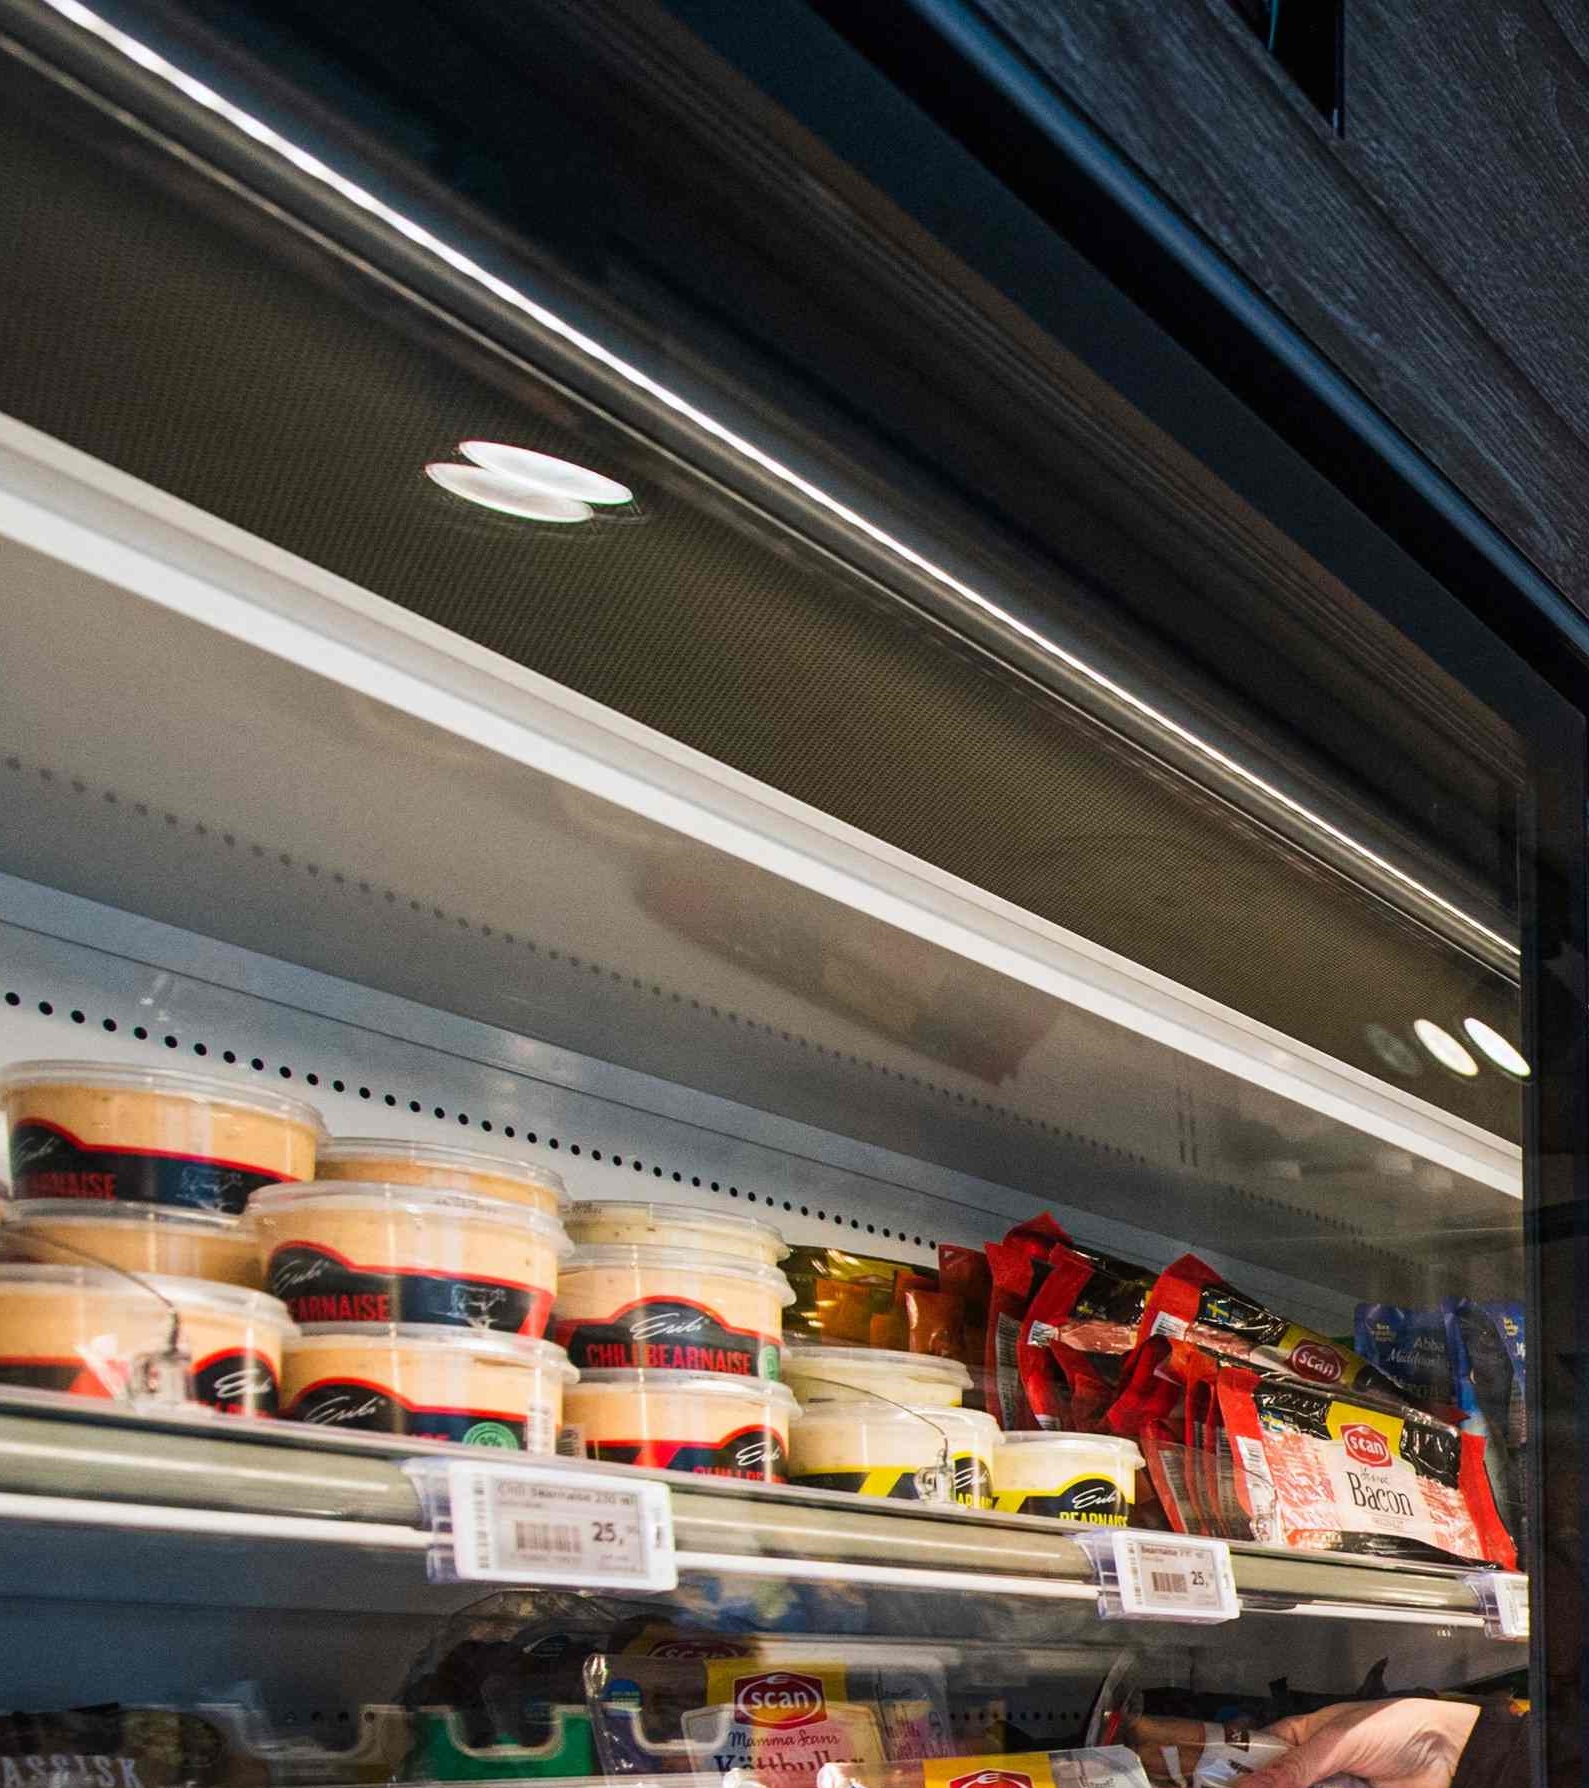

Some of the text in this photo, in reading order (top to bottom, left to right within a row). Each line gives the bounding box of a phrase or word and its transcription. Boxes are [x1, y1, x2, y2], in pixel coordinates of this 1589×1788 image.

[587, 1343, 752, 1375] CHILI BEARNAISE
[1299, 1350, 1334, 1376] scan
[1350, 1434, 1384, 1456] scan
[1345, 1470, 1415, 1517] Bacon
[750, 1686, 809, 1709] scan
